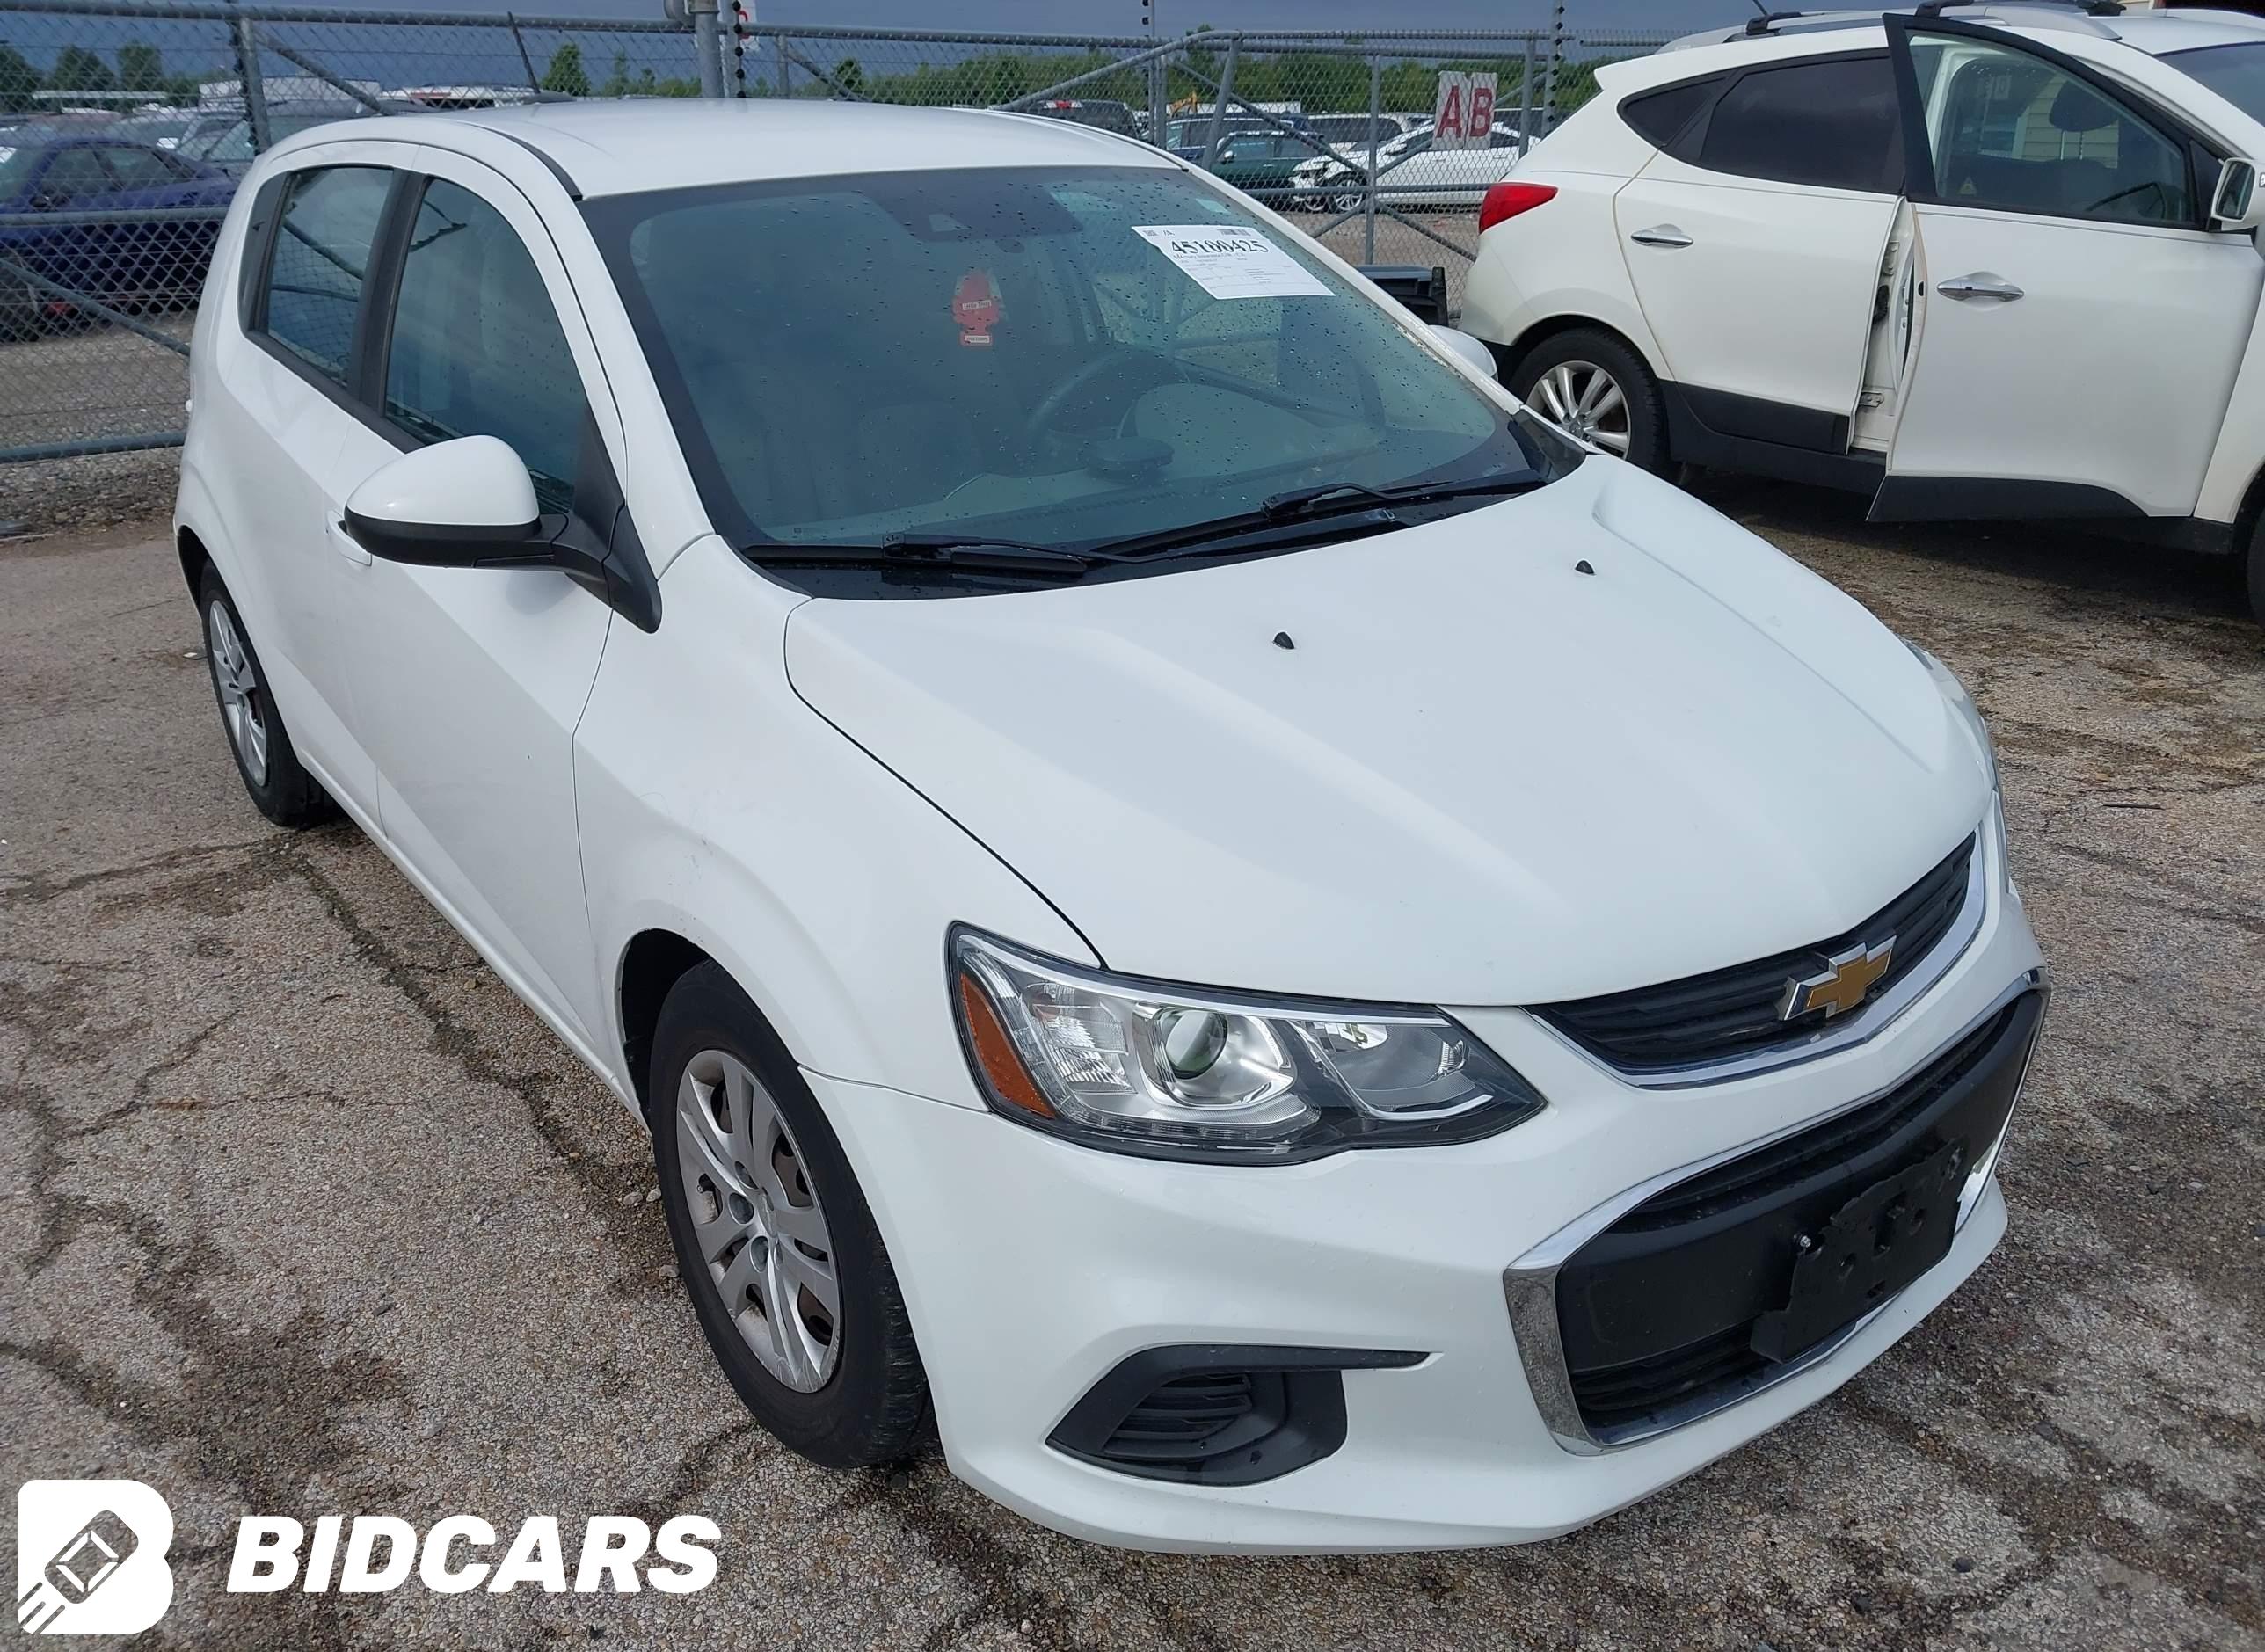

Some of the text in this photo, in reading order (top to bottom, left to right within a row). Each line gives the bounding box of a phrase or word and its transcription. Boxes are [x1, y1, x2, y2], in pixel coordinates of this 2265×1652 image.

[1435, 85, 1493, 138] A B
[1171, 239, 1269, 254] 45100425
